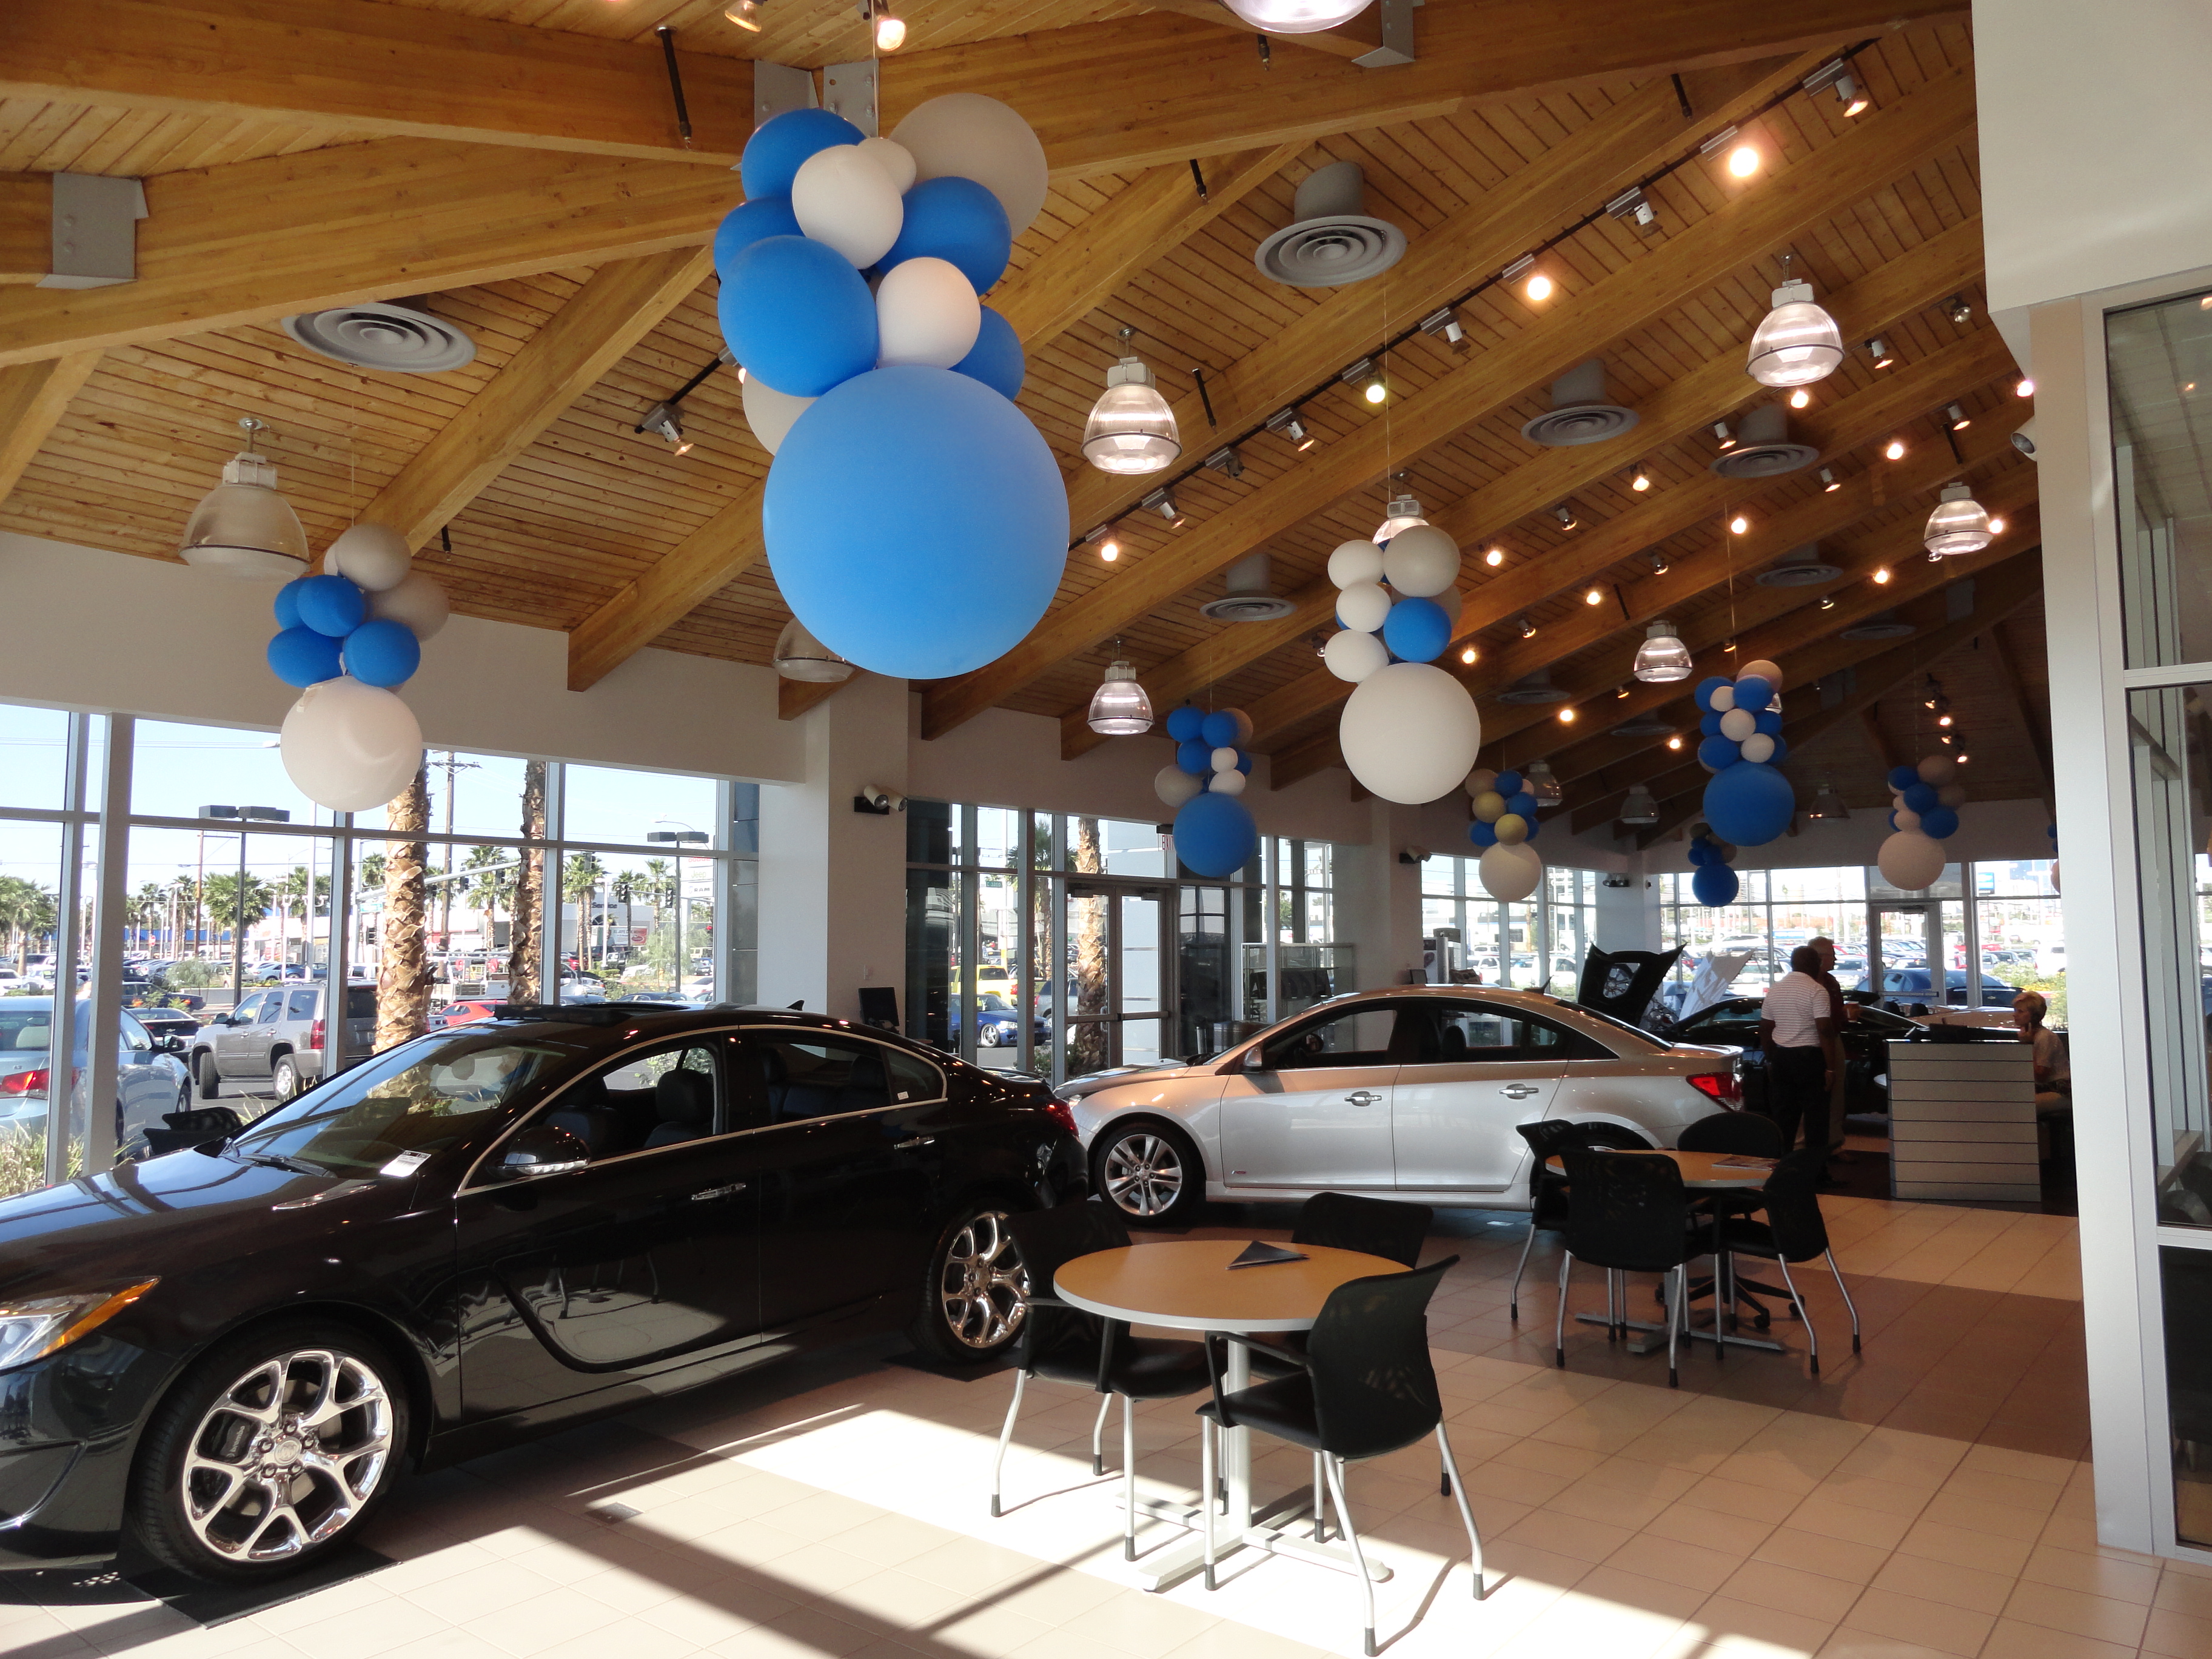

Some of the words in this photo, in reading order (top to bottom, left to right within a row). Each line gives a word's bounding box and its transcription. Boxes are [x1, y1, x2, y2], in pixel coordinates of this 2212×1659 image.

[1162, 835, 1174, 850] EXIT
[691, 871, 706, 879] Jeep
[229, 1426, 245, 1452] brembo
